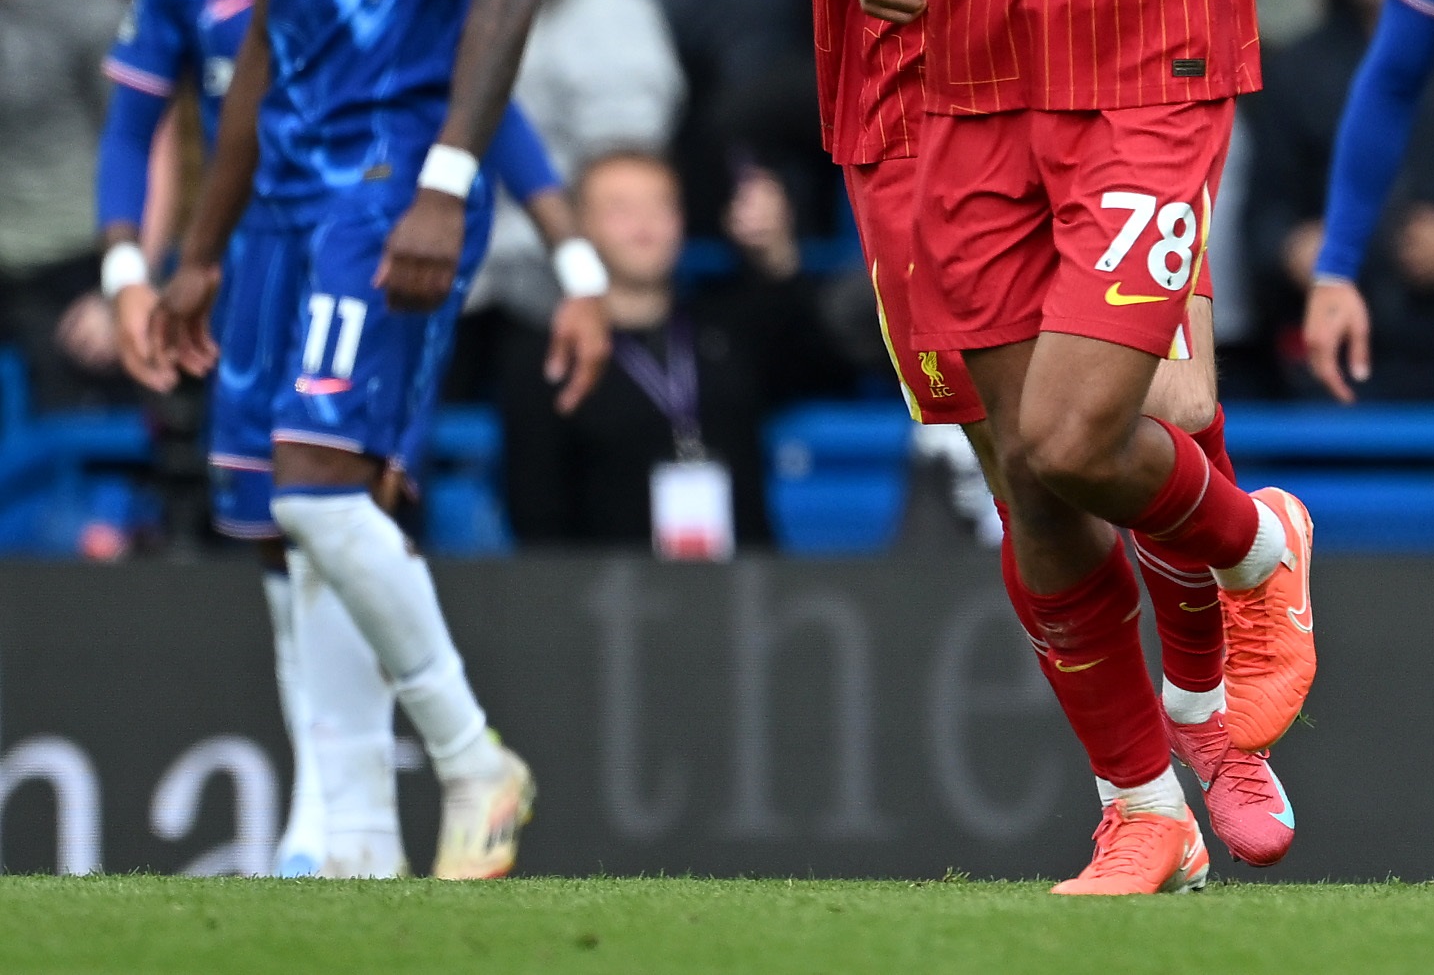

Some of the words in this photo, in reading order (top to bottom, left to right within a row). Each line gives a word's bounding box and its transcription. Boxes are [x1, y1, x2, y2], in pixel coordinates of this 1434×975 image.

[1095, 192, 1197, 291] 78
[302, 292, 368, 379] 11
[583, 561, 1066, 844] the
